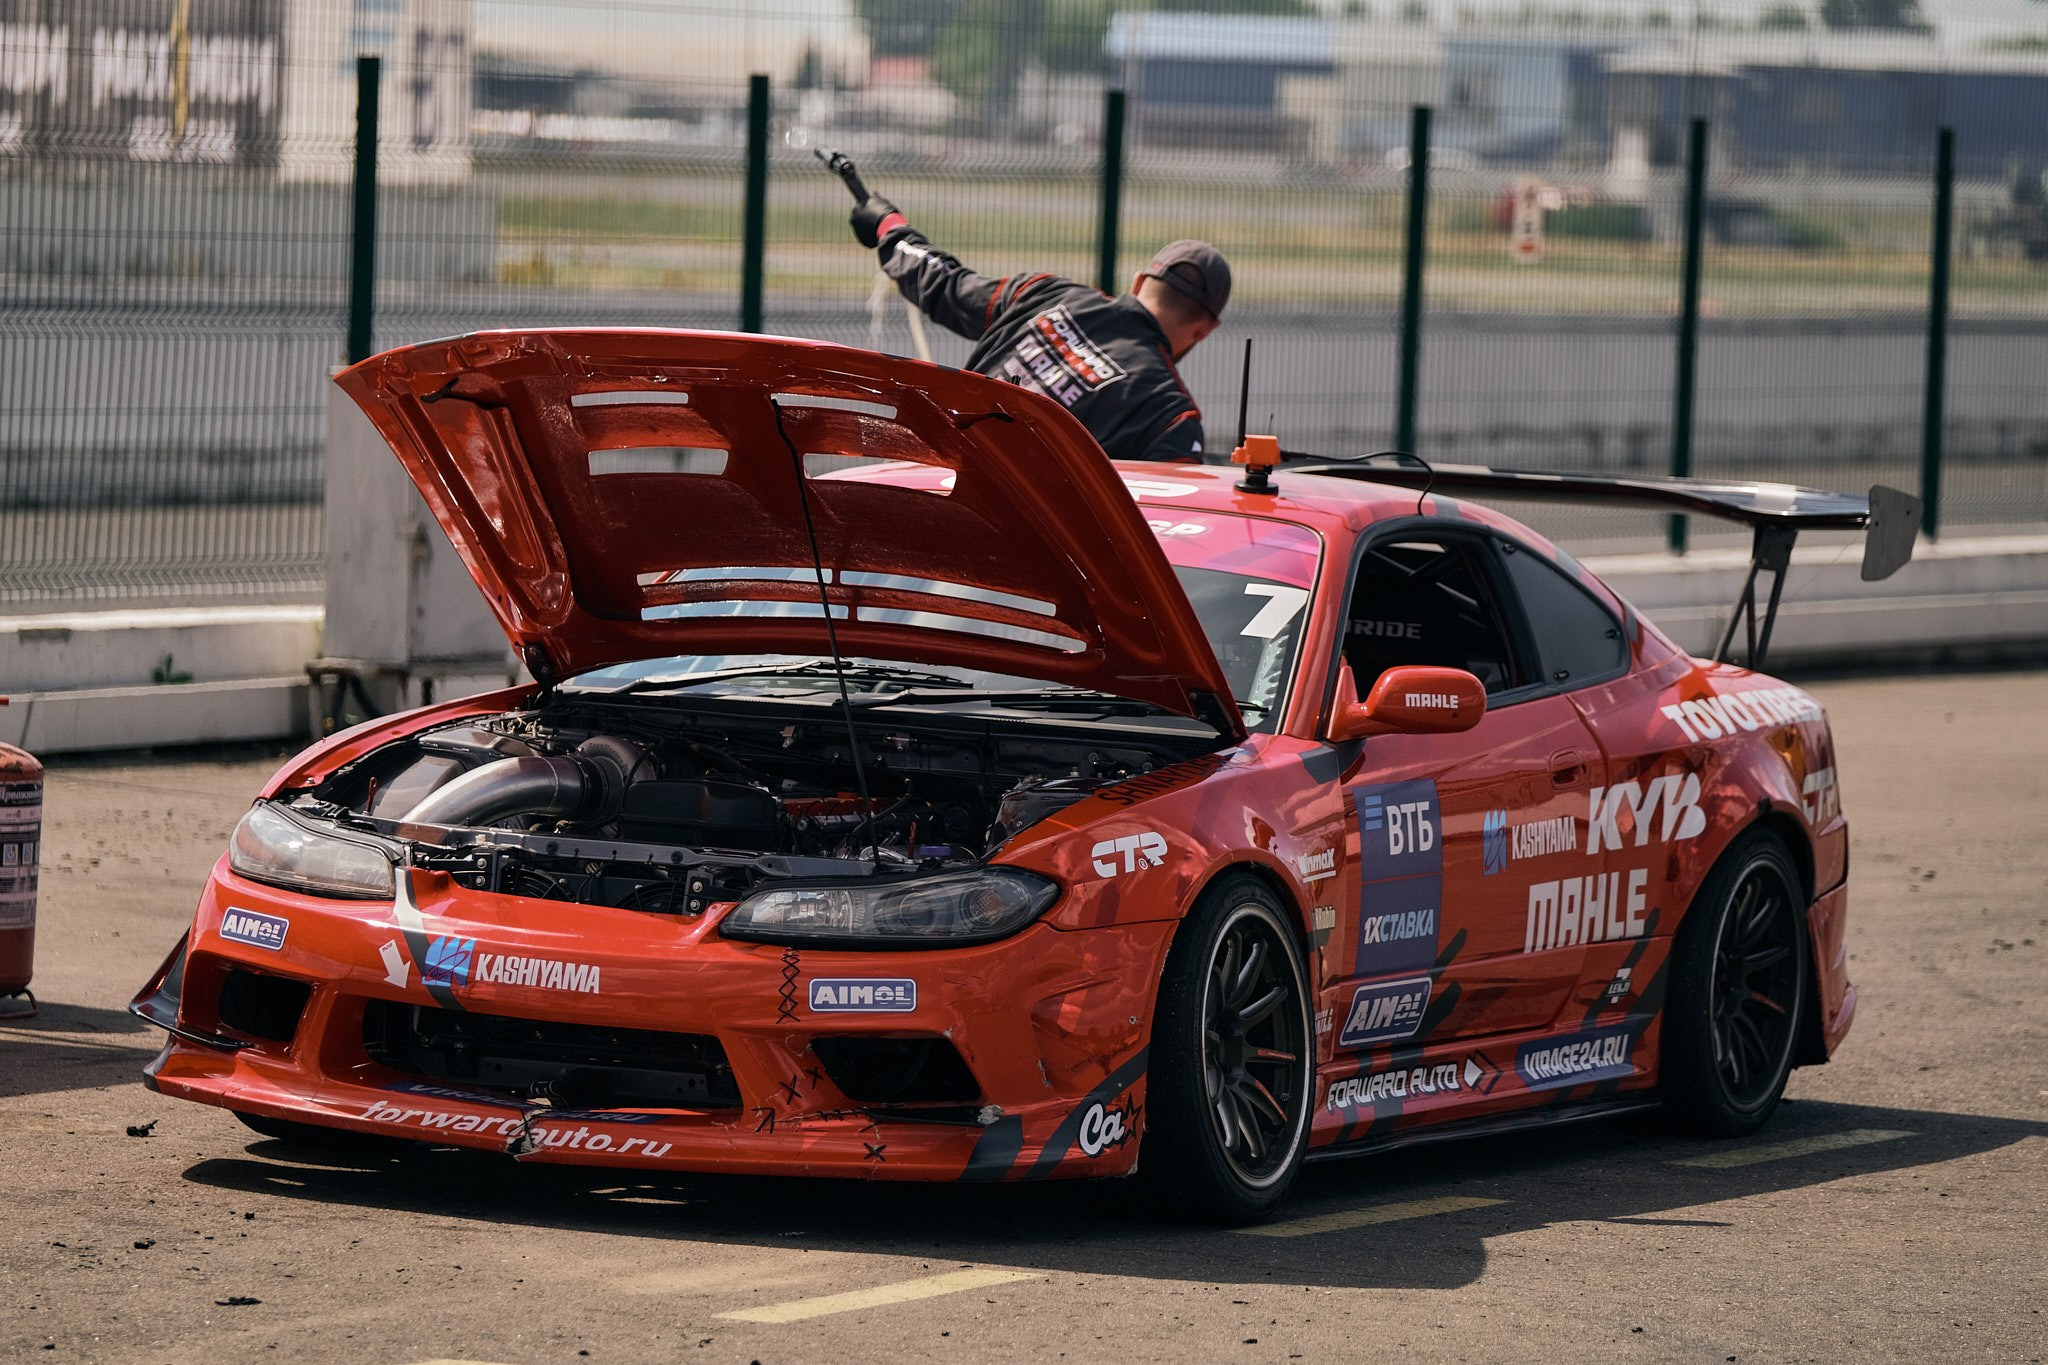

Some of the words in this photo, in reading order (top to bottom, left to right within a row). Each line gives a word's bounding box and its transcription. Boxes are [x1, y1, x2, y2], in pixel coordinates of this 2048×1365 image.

[1016, 334, 1083, 407] MAHLE
[1041, 320, 1098, 382] RACING
[1240, 583, 1310, 639] 7
[1405, 692, 1459, 710] MAHLE
[1659, 694, 1758, 743] TOYO
[1386, 801, 1434, 856] ВТБ
[1586, 772, 1707, 855] KYB
[1092, 831, 1168, 878] CTR
[1512, 816, 1577, 860] KASHIYAMA
[223, 914, 281, 943] AIMOL
[1523, 868, 1648, 954] MAHLE
[475, 953, 600, 994] KASHIYAMA
[814, 986, 911, 1005] AIMOL
[1346, 992, 1422, 1033] AIMOL
[1524, 1034, 1630, 1080] VIRAGE24.RU
[1327, 1070, 1408, 1111] FORWARD
[1410, 1063, 1459, 1095] AUTO
